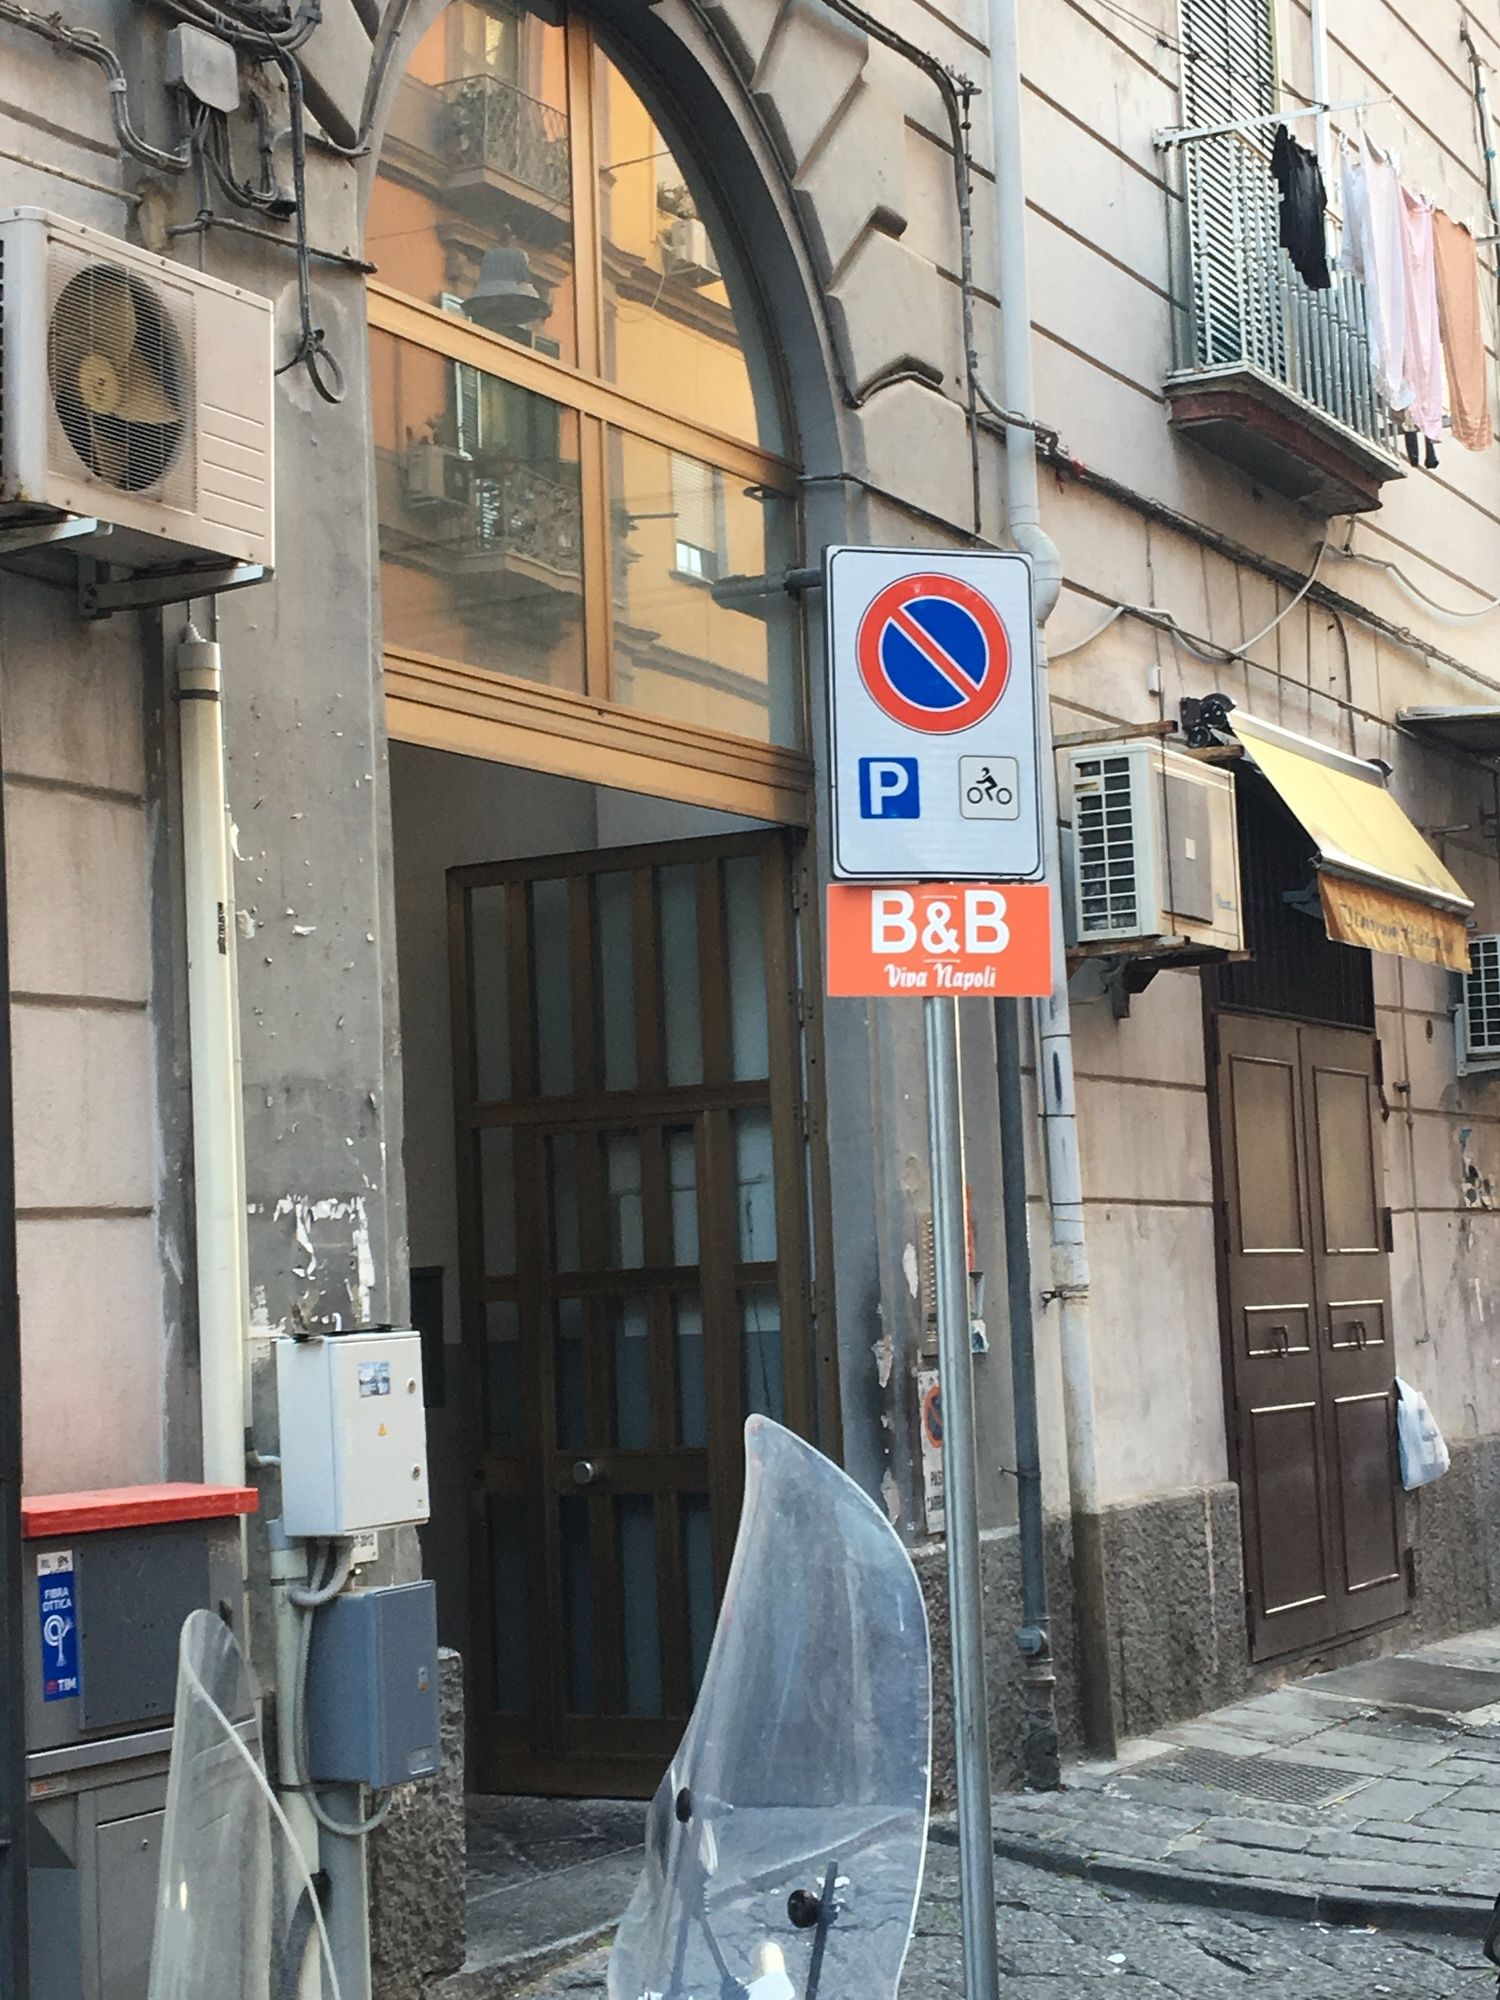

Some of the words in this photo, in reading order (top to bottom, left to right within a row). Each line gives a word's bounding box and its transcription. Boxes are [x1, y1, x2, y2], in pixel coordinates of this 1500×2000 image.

[869, 761, 909, 815] P
[871, 890, 1010, 954] B&B
[884, 963, 928, 988] Viva
[933, 962, 996, 991] Napoli
[44, 1587, 69, 1599] FIBRA
[42, 1598, 72, 1612] OTTICA
[57, 1677, 77, 1692] TIM
